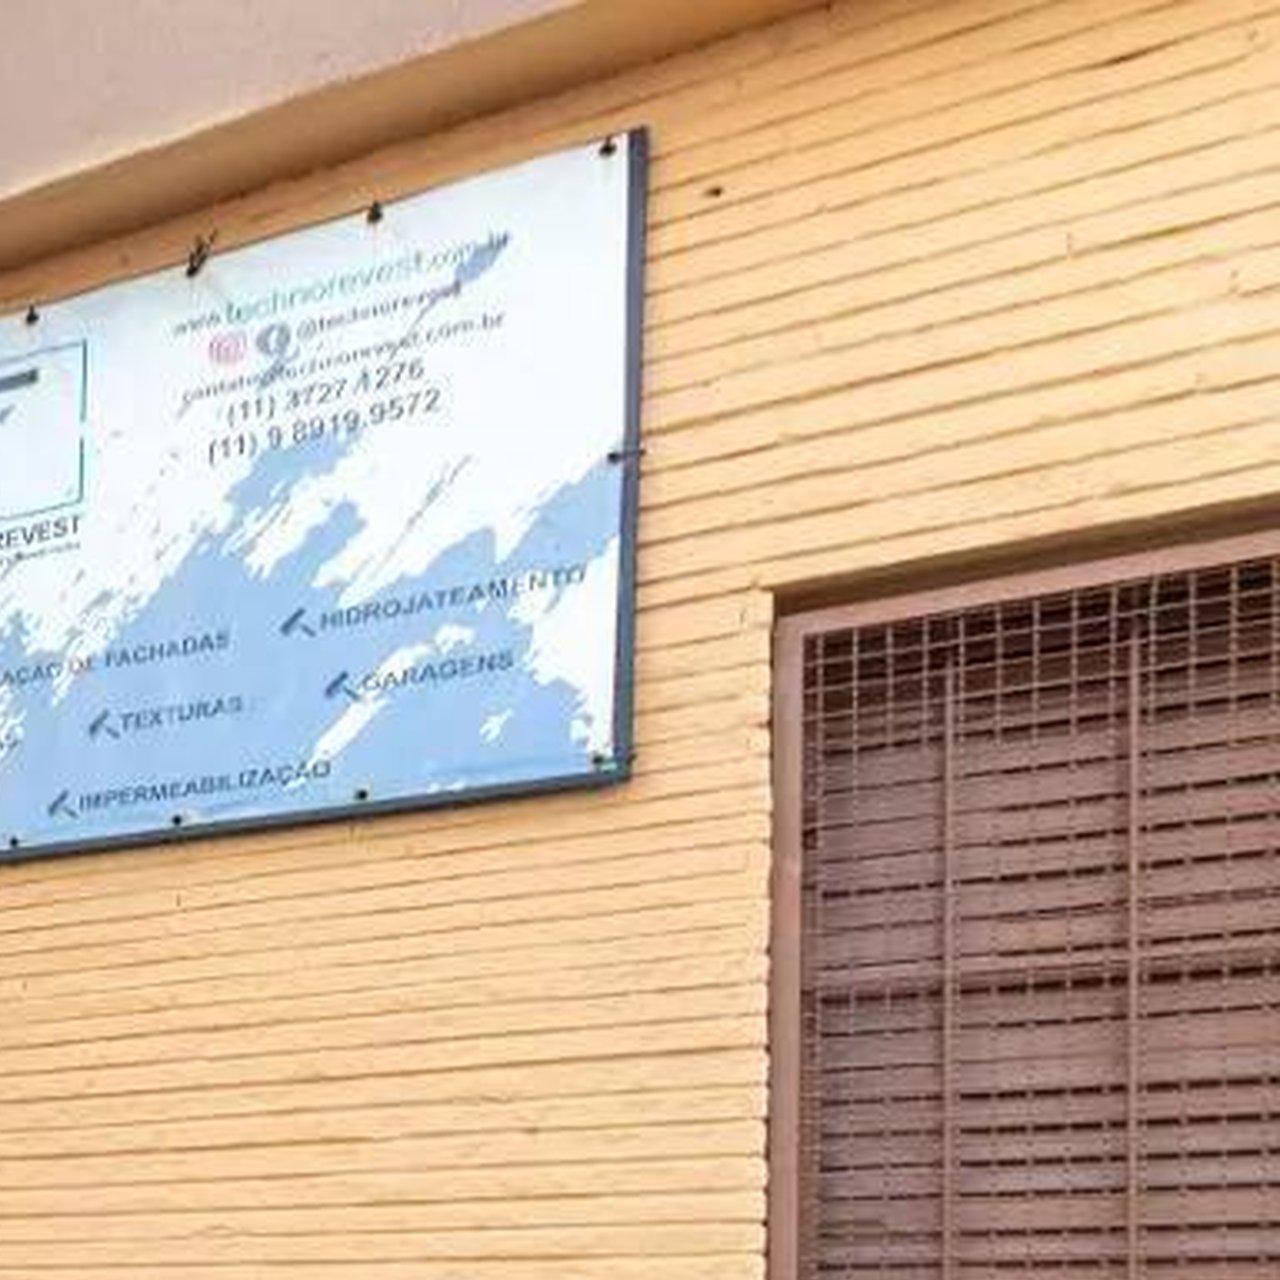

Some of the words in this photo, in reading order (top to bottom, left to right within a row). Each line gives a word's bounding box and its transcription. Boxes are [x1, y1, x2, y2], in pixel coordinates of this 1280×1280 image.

[207, 430, 258, 466] (11)
[266, 423, 283, 450] 9
[318, 562, 588, 632] HIDROJATEAMENTO
[103, 630, 232, 668] FACHADAS
[358, 648, 517, 692] GARAGENS
[119, 697, 245, 734] TEXTURAS
[77, 757, 333, 814] IMPERMEABILIZAÇÃO
